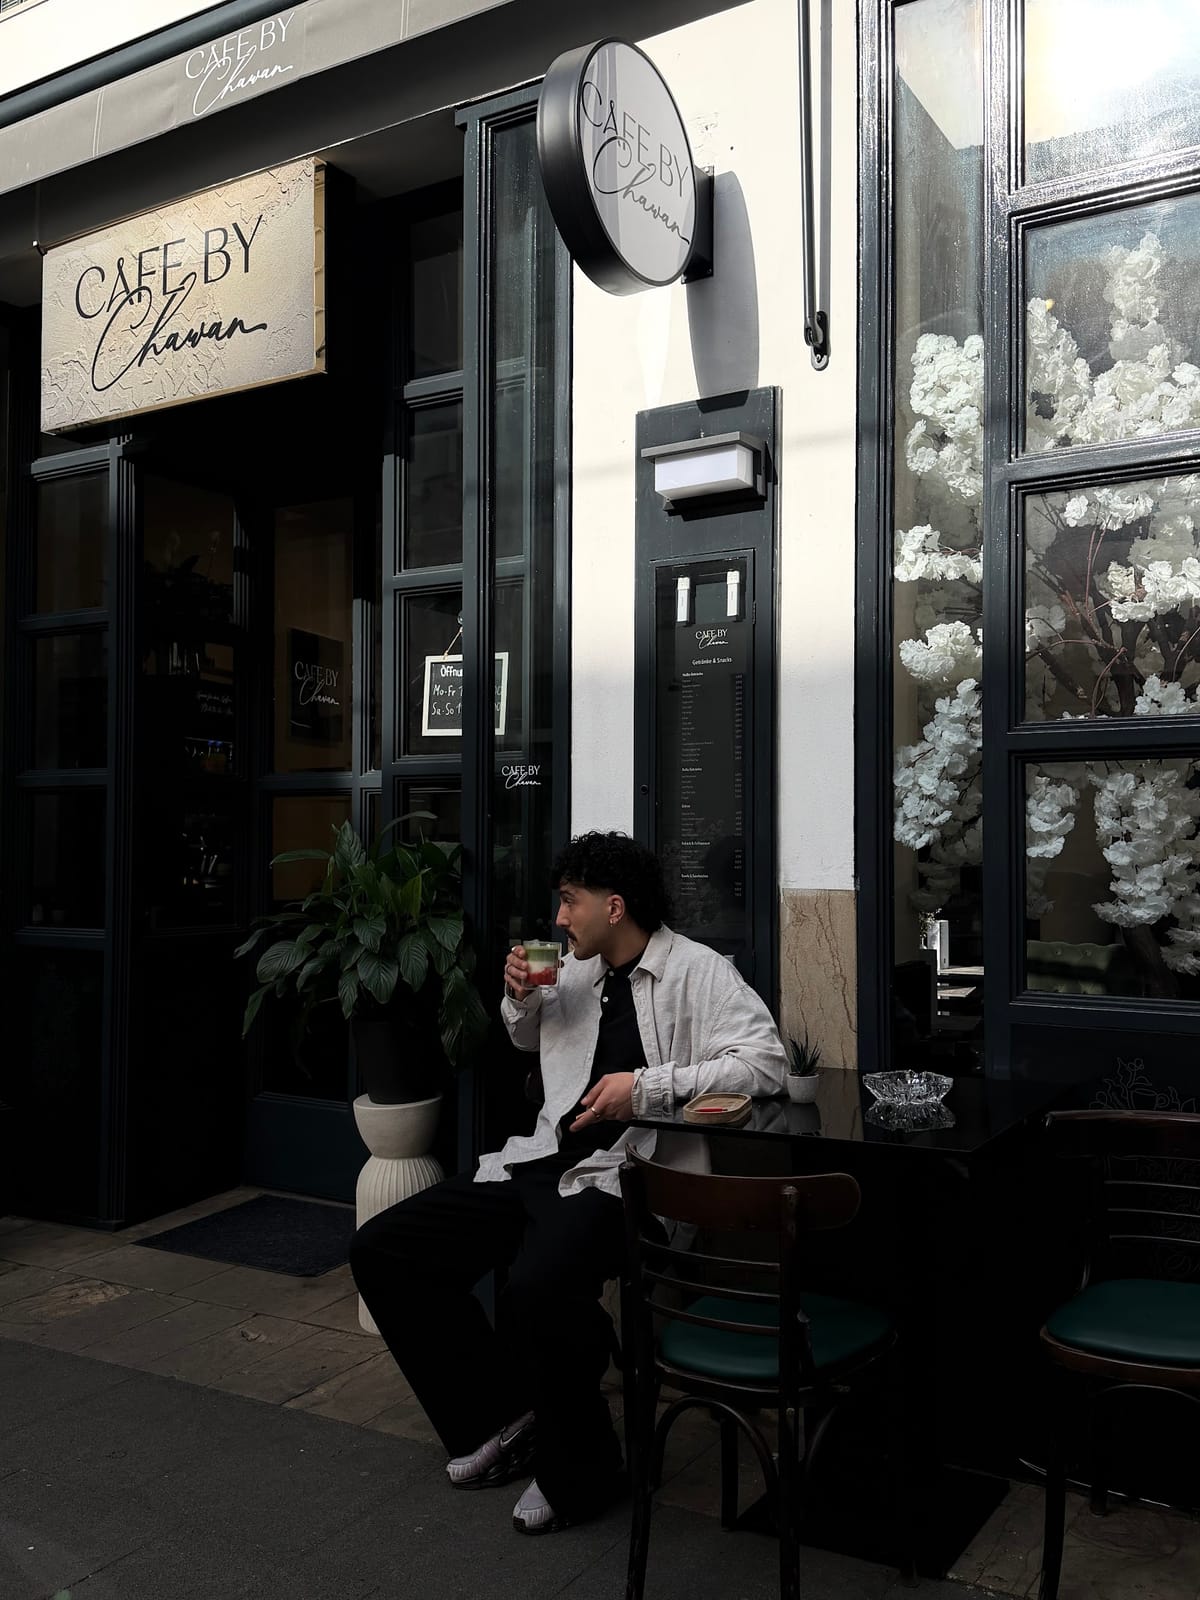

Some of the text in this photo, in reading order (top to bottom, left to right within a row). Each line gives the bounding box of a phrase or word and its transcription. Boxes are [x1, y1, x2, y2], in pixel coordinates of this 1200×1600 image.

[185, 12, 295, 79] CAFE BY
[192, 45, 294, 116] Chawan
[581, 81, 689, 197] CAFE BY
[592, 163, 690, 245] Chawan
[75, 214, 263, 319] CAFE BY
[91, 271, 268, 391] Chawan
[695, 628, 728, 640] CAFE BY
[294, 660, 339, 688] CAFE BY
[501, 765, 541, 776] CAFE BY
